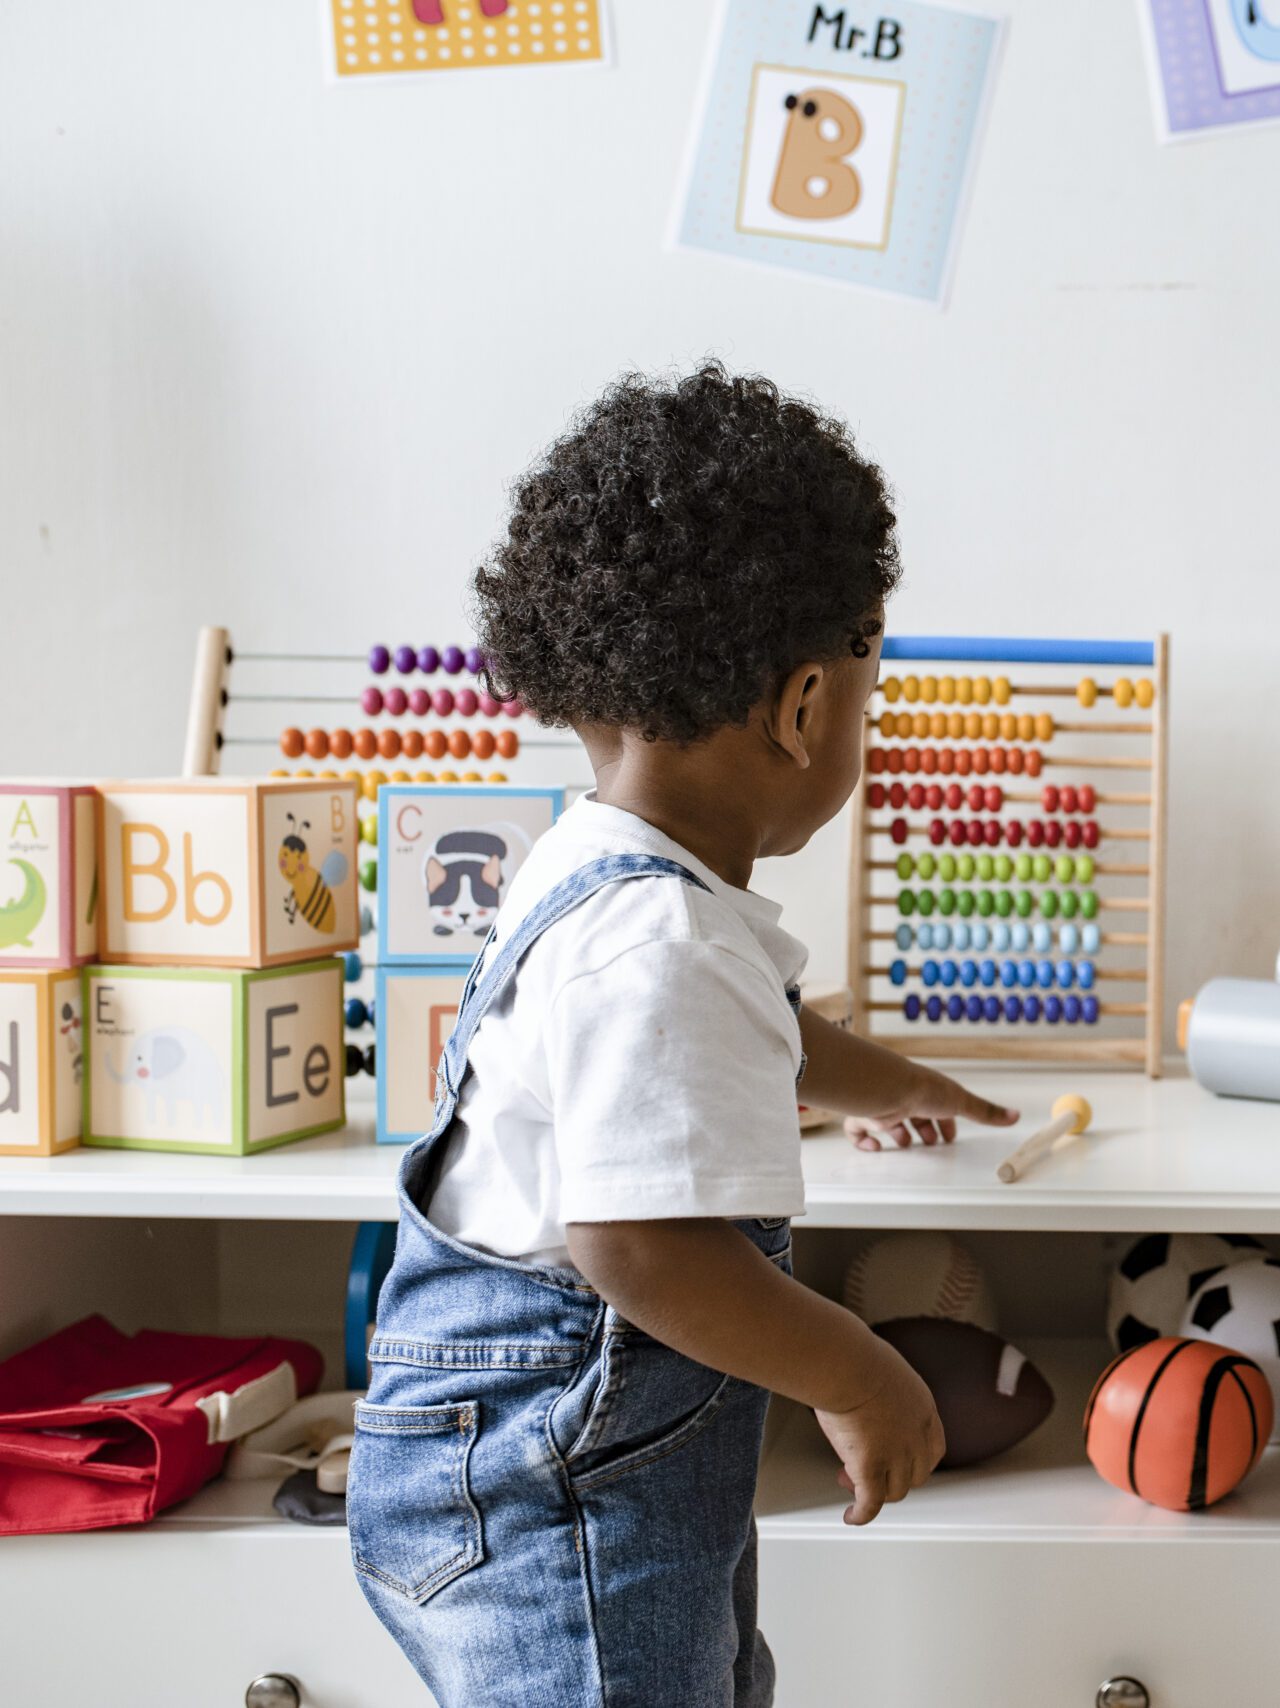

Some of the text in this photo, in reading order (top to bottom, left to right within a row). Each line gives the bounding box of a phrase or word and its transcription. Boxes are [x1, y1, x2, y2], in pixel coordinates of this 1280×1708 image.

[807, 3, 902, 61] Mr.B
[770, 87, 863, 221] B
[10, 799, 39, 838] A
[330, 795, 344, 833] B
[397, 804, 423, 842] C
[121, 822, 232, 926] Bb
[97, 986, 114, 1024] E
[266, 1003, 330, 1108] Ee
